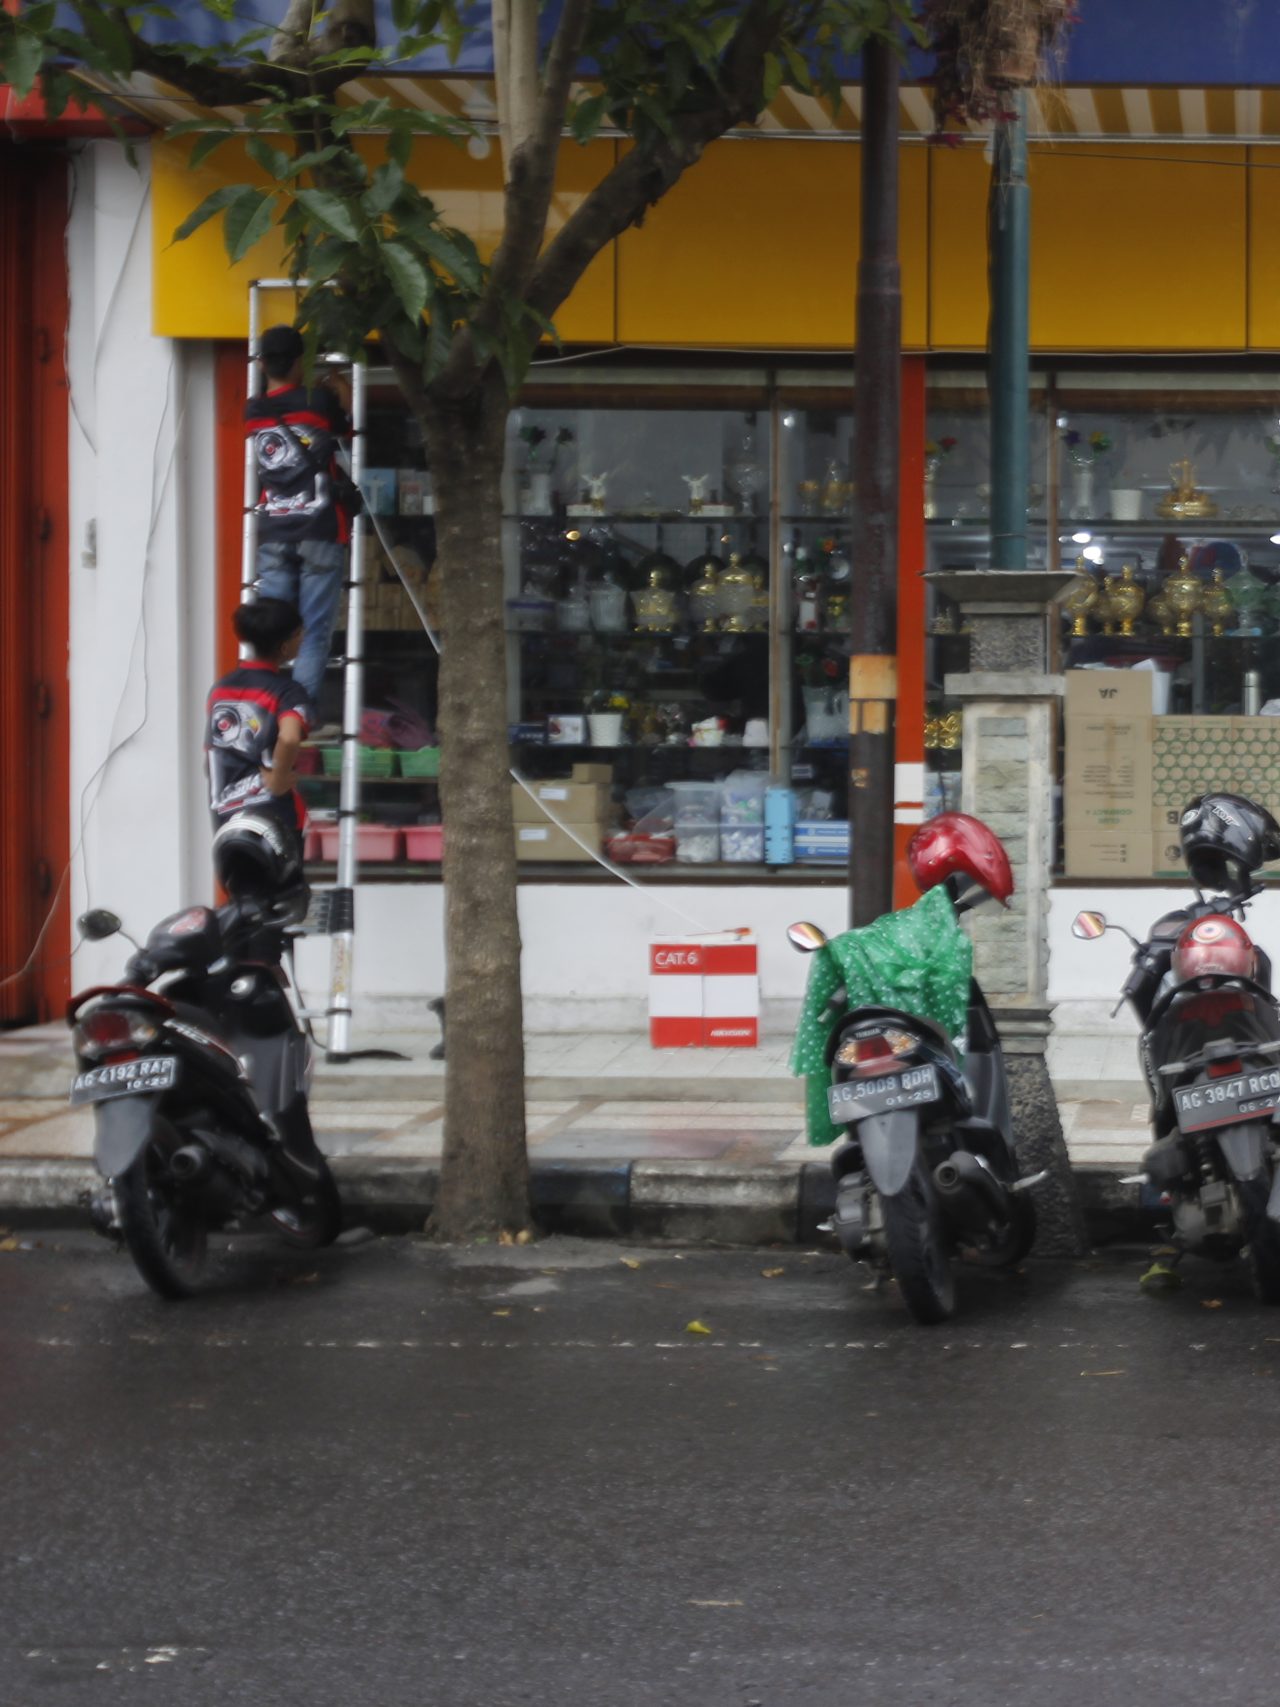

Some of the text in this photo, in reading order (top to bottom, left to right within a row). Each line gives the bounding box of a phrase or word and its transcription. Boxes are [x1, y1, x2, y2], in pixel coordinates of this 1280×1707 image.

[98, 1063, 136, 1085] 4192
[1182, 1092, 1202, 1112] AG
[1205, 1081, 1245, 1104] 3847
